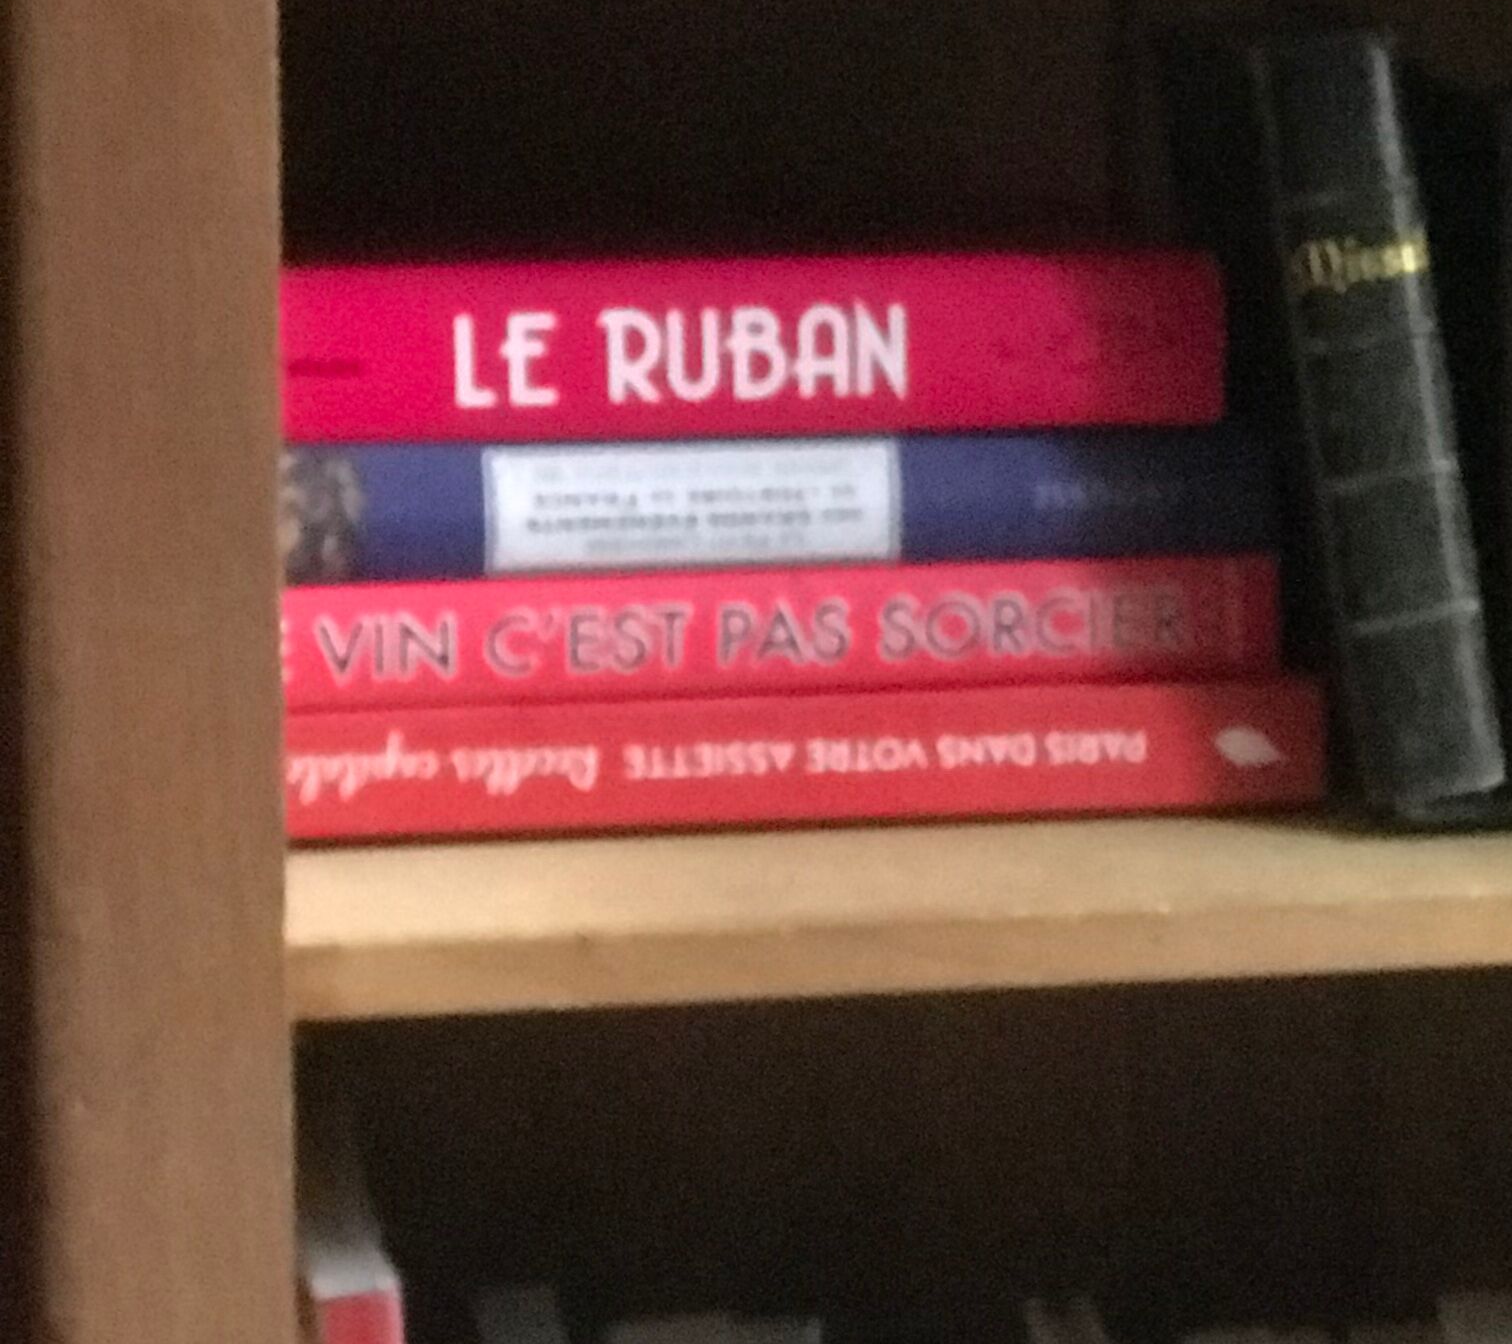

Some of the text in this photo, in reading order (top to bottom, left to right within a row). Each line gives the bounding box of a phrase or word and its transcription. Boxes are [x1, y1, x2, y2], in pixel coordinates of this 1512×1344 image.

[452, 299, 908, 409] LE RUBAN
[316, 587, 1190, 684] VIN C'EST PAS SORCIER
[284, 729, 441, 806] capitale
[624, 742, 797, 780] ASSIETTE
[807, 737, 926, 773] VOTRE
[937, 733, 1035, 769] DANS
[1047, 729, 1148, 768] PARIS
